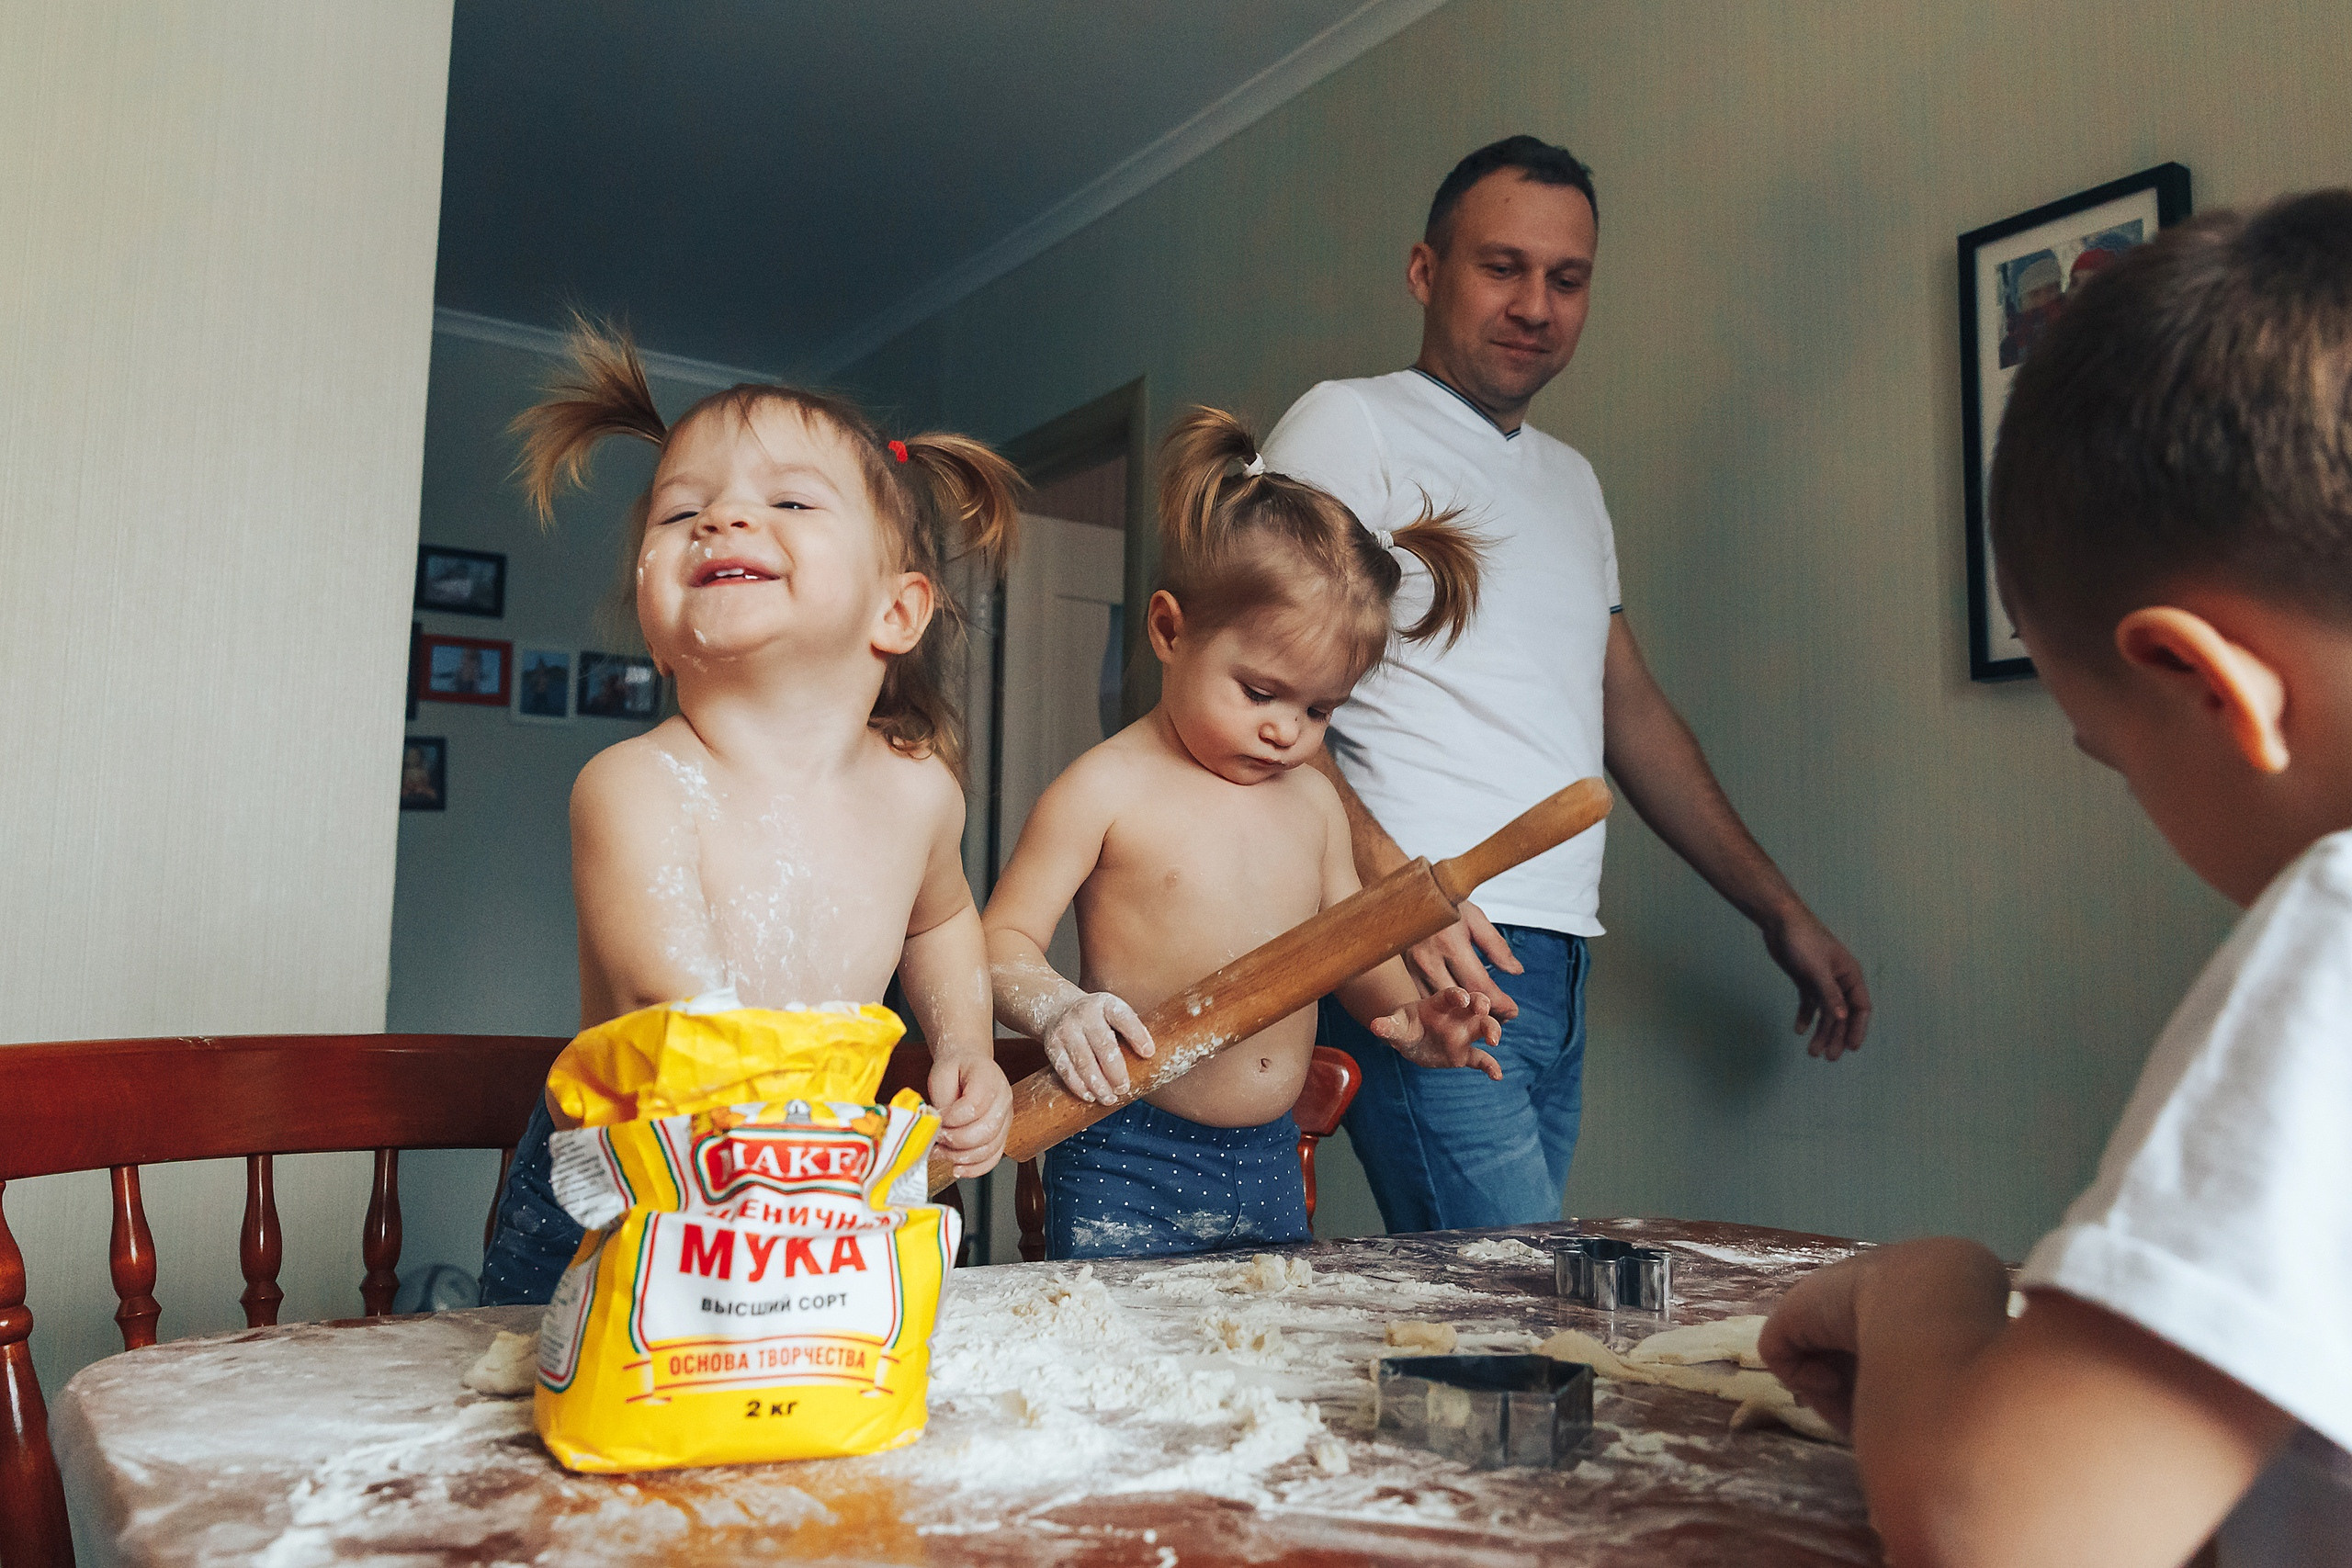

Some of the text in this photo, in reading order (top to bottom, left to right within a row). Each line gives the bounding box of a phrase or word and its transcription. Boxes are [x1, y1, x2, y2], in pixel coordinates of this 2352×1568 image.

[705, 1198, 890, 1230] ЕНИЧН
[679, 1223, 867, 1282] МУКА
[701, 1292, 848, 1316] ВЫСШИЙ СОРТ
[669, 1346, 865, 1376] ОСНОВА ТВОРЧЕСТВА
[746, 1400, 798, 1417] 2 кг
